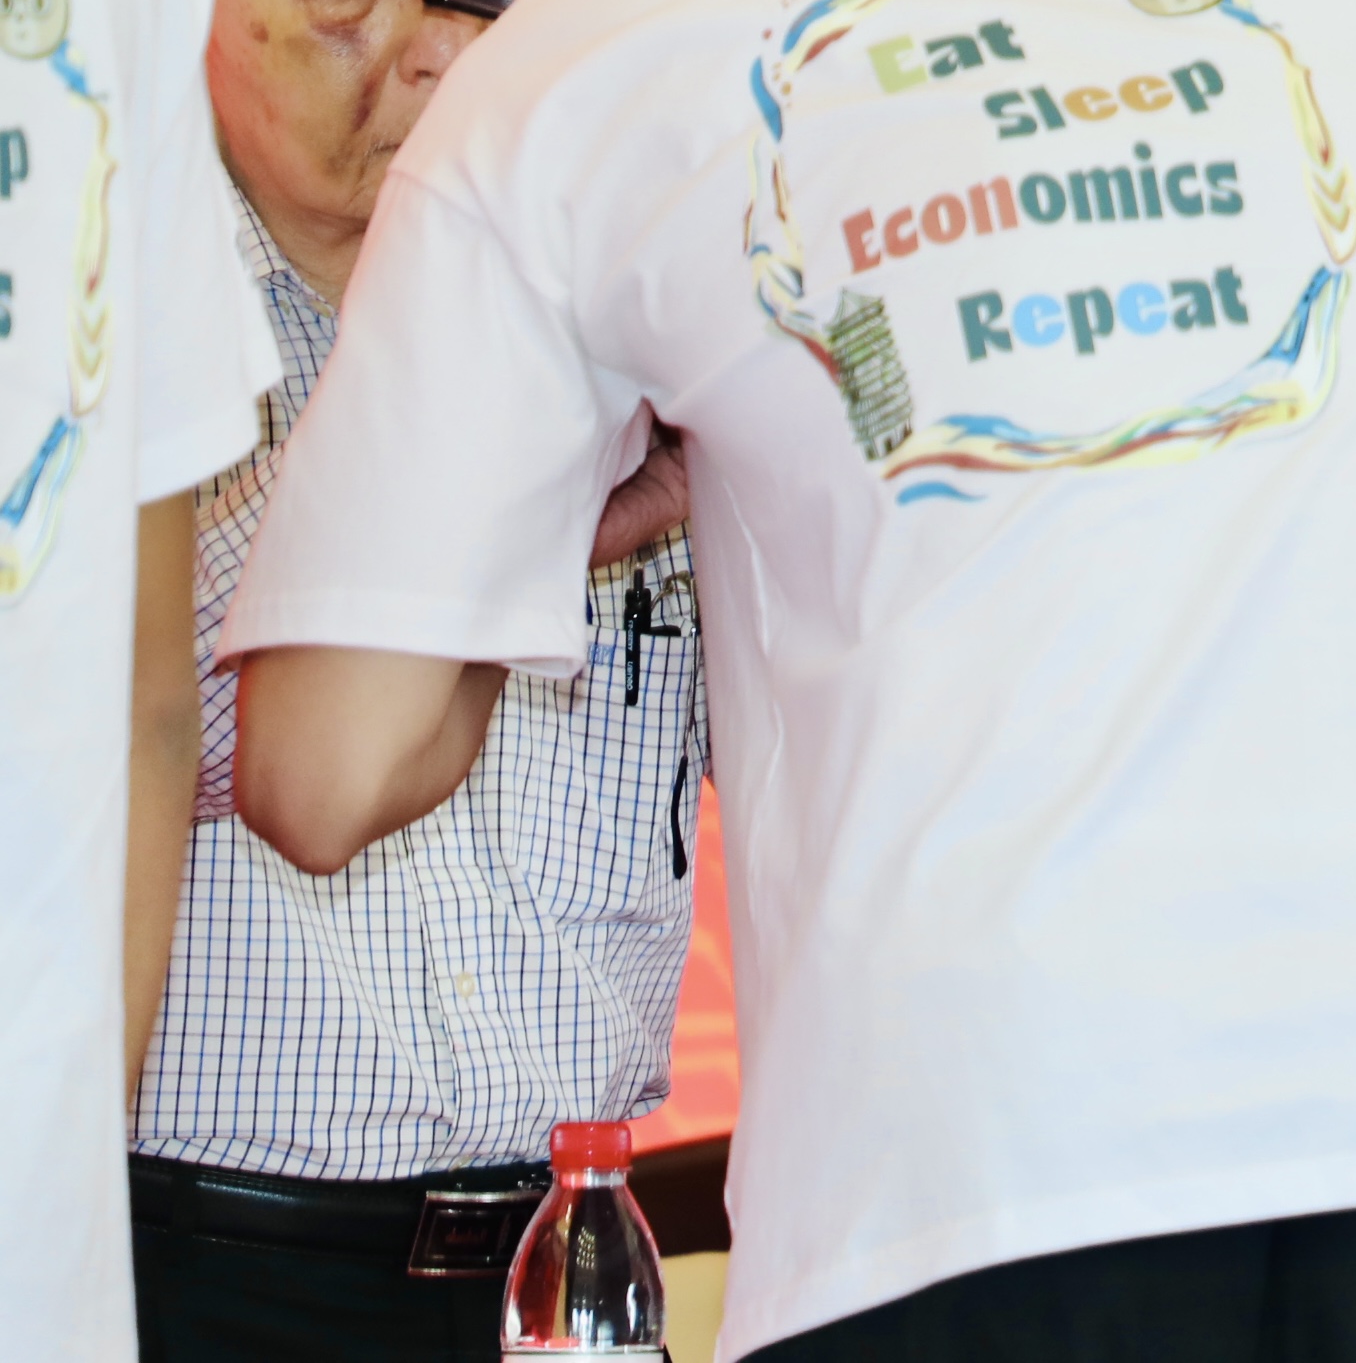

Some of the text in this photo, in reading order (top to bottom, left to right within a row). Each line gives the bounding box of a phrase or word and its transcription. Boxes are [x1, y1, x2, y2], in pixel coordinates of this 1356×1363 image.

[867, 18, 1025, 94] Eat
[842, 142, 1243, 274] Economics
[957, 264, 1249, 363] Repeat
